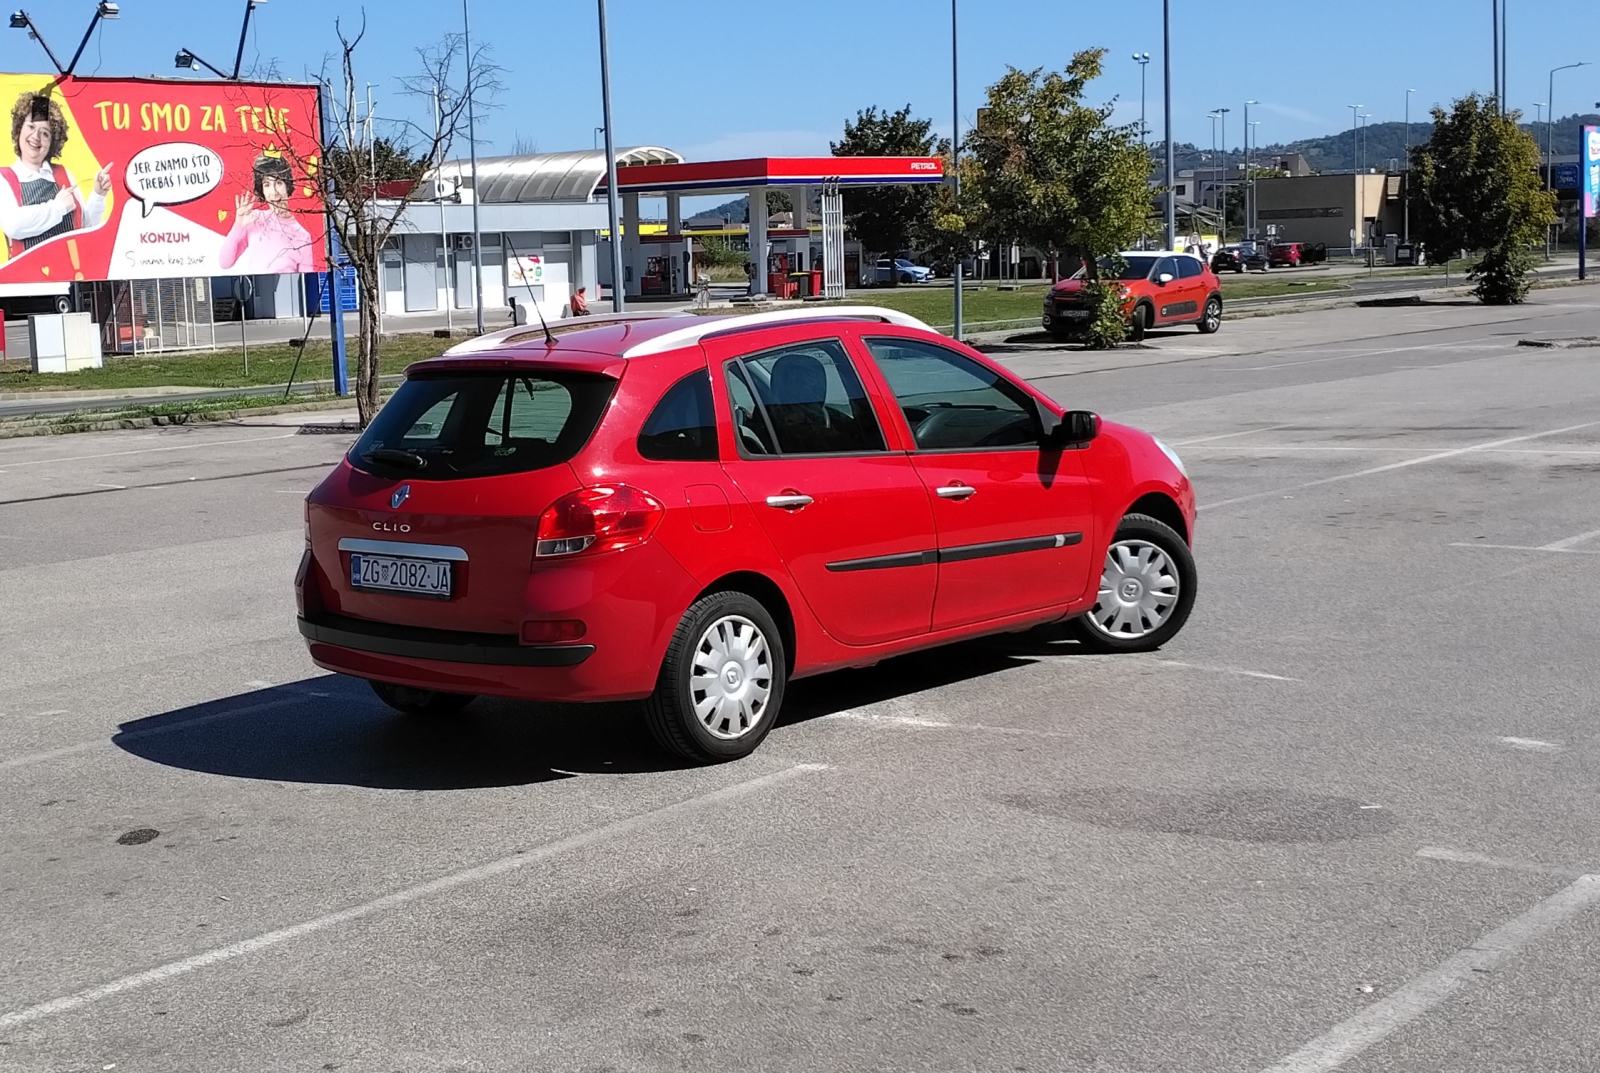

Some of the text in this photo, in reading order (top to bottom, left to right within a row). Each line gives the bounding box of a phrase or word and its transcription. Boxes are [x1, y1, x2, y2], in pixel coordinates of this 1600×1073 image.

[93, 101, 130, 131] TU
[140, 102, 191, 132] SMO
[200, 104, 227, 133] ZA
[134, 153, 210, 175] JER ZNAMO ŠTO
[910, 162, 938, 170] PETROL
[140, 231, 190, 244] KONZUM
[372, 522, 411, 533] CLIO
[362, 560, 380, 583] ZG
